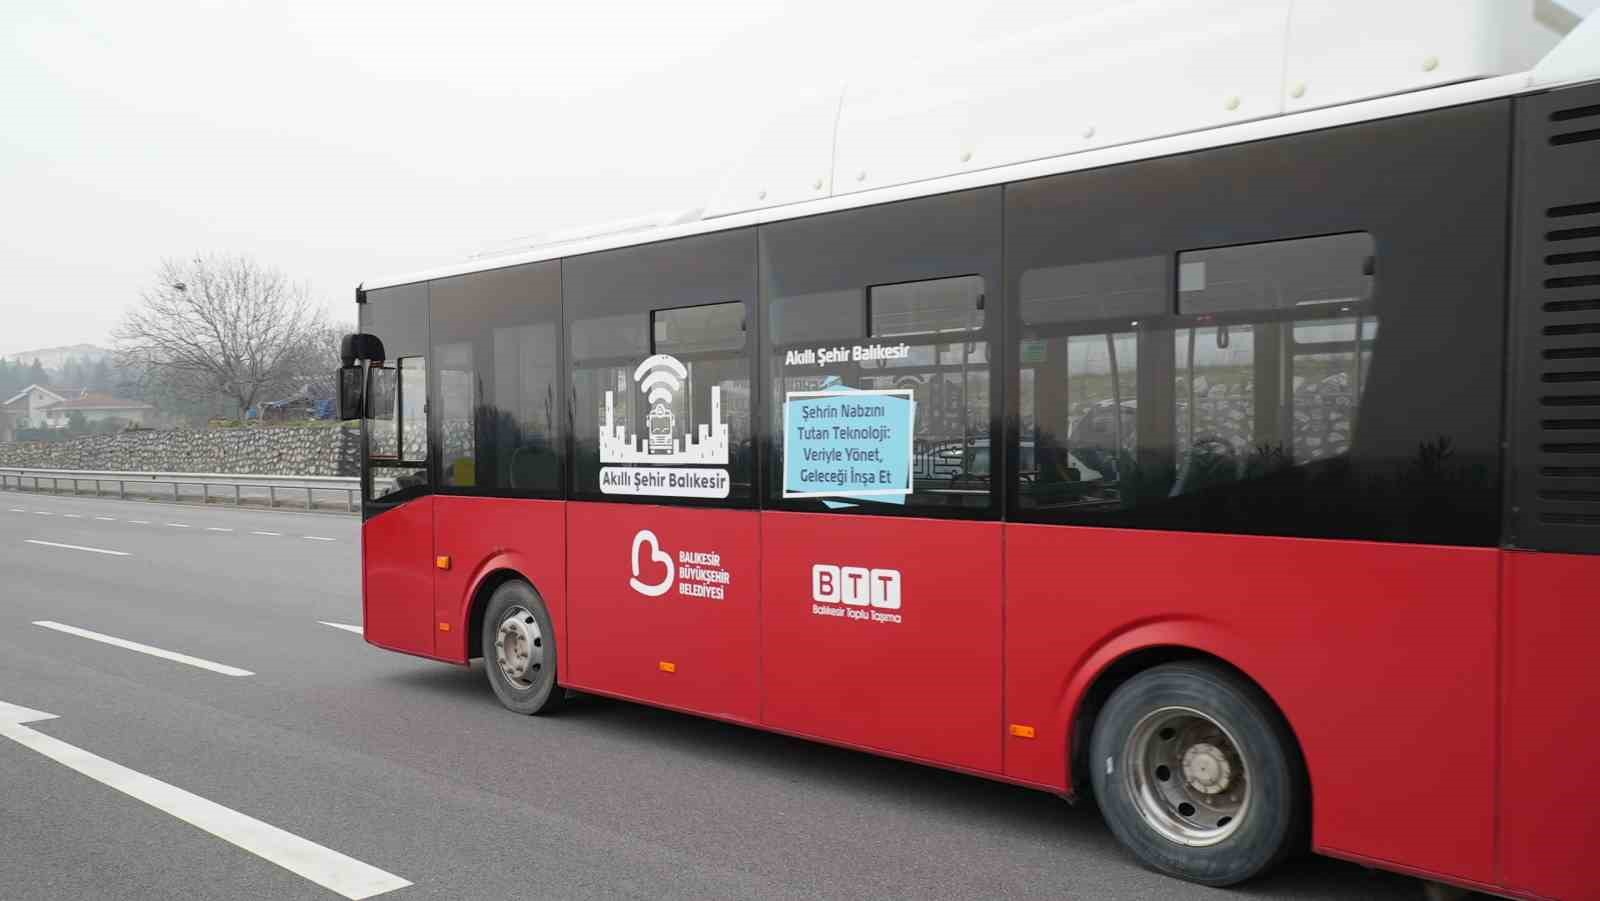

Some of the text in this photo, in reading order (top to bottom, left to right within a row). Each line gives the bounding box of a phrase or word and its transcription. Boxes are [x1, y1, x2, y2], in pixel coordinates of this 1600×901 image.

[785, 342, 910, 367] Akıllı Şehir Balıkesir
[802, 404, 885, 421] Şehrin Nabzını
[797, 425, 891, 441] Tutan Teknoloji:
[803, 448, 883, 464] Veriyle Yönet,
[602, 471, 727, 492] Akıllı Şehir Balıkesir
[800, 466, 892, 486] Geleceği İnşa Et
[679, 550, 720, 566] BALIKESİR
[679, 564, 730, 585] BÜYÜKŞEHİR
[679, 582, 724, 600] BELEDİYESİ
[819, 570, 894, 603] BTT
